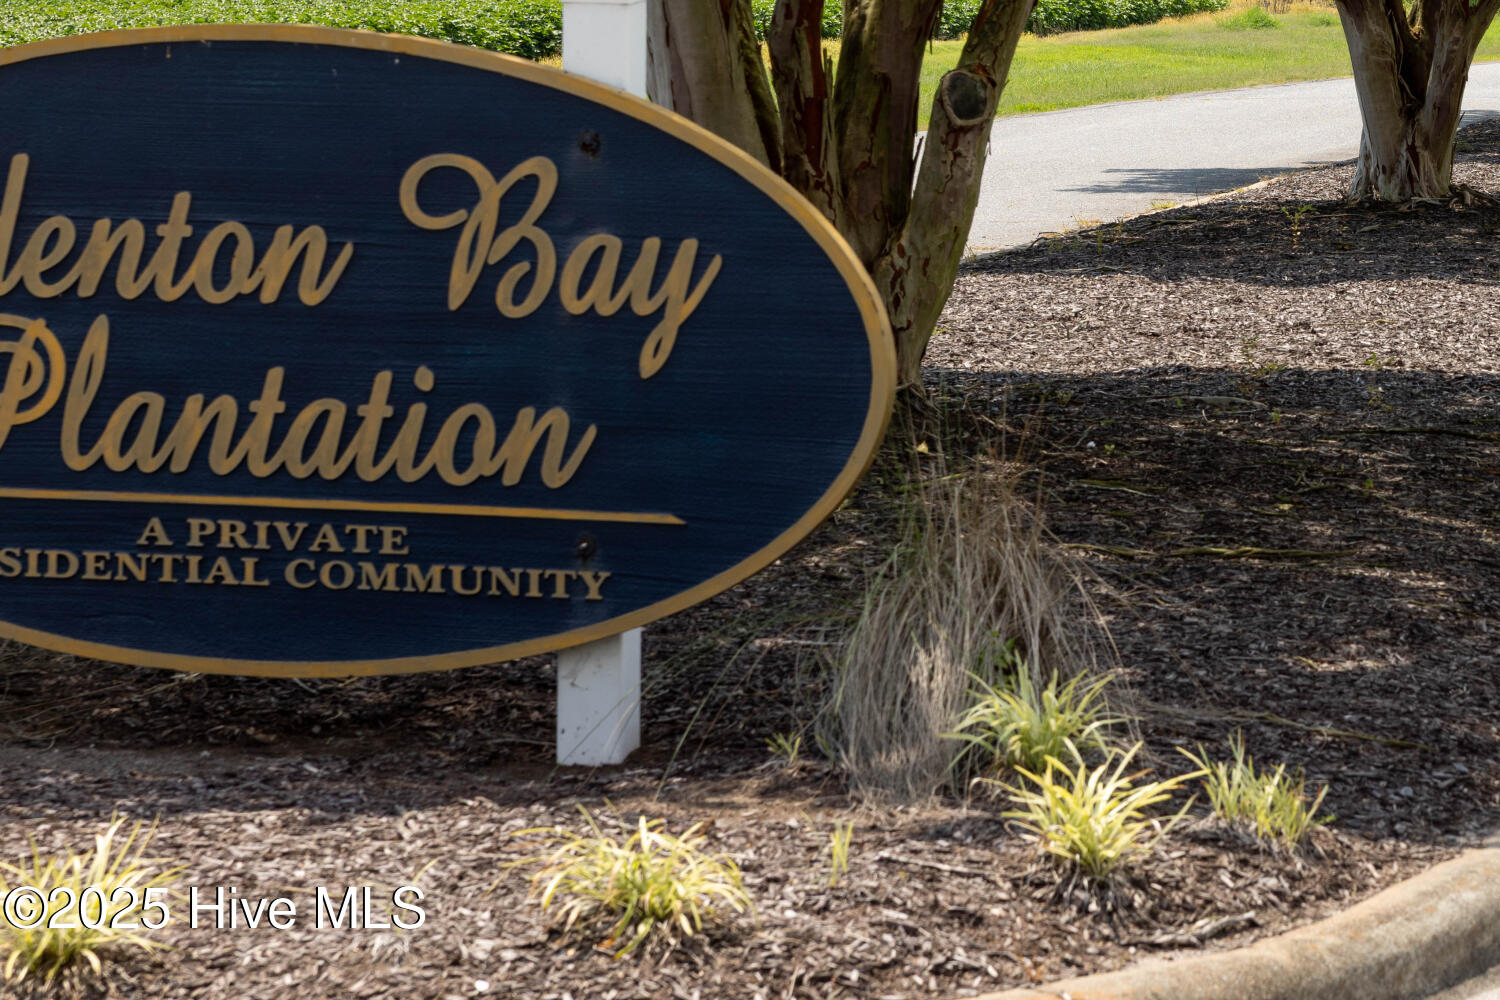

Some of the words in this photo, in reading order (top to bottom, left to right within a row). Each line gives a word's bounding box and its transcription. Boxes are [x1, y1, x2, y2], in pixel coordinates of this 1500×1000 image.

[400, 152, 722, 380] Bay
[0, 313, 597, 489] Plantation
[0, 548, 270, 586] SIDENTIAL
[284, 558, 612, 600] COMMUNITY
[136, 517, 173, 546] A
[186, 518, 410, 555] PRIVATE
